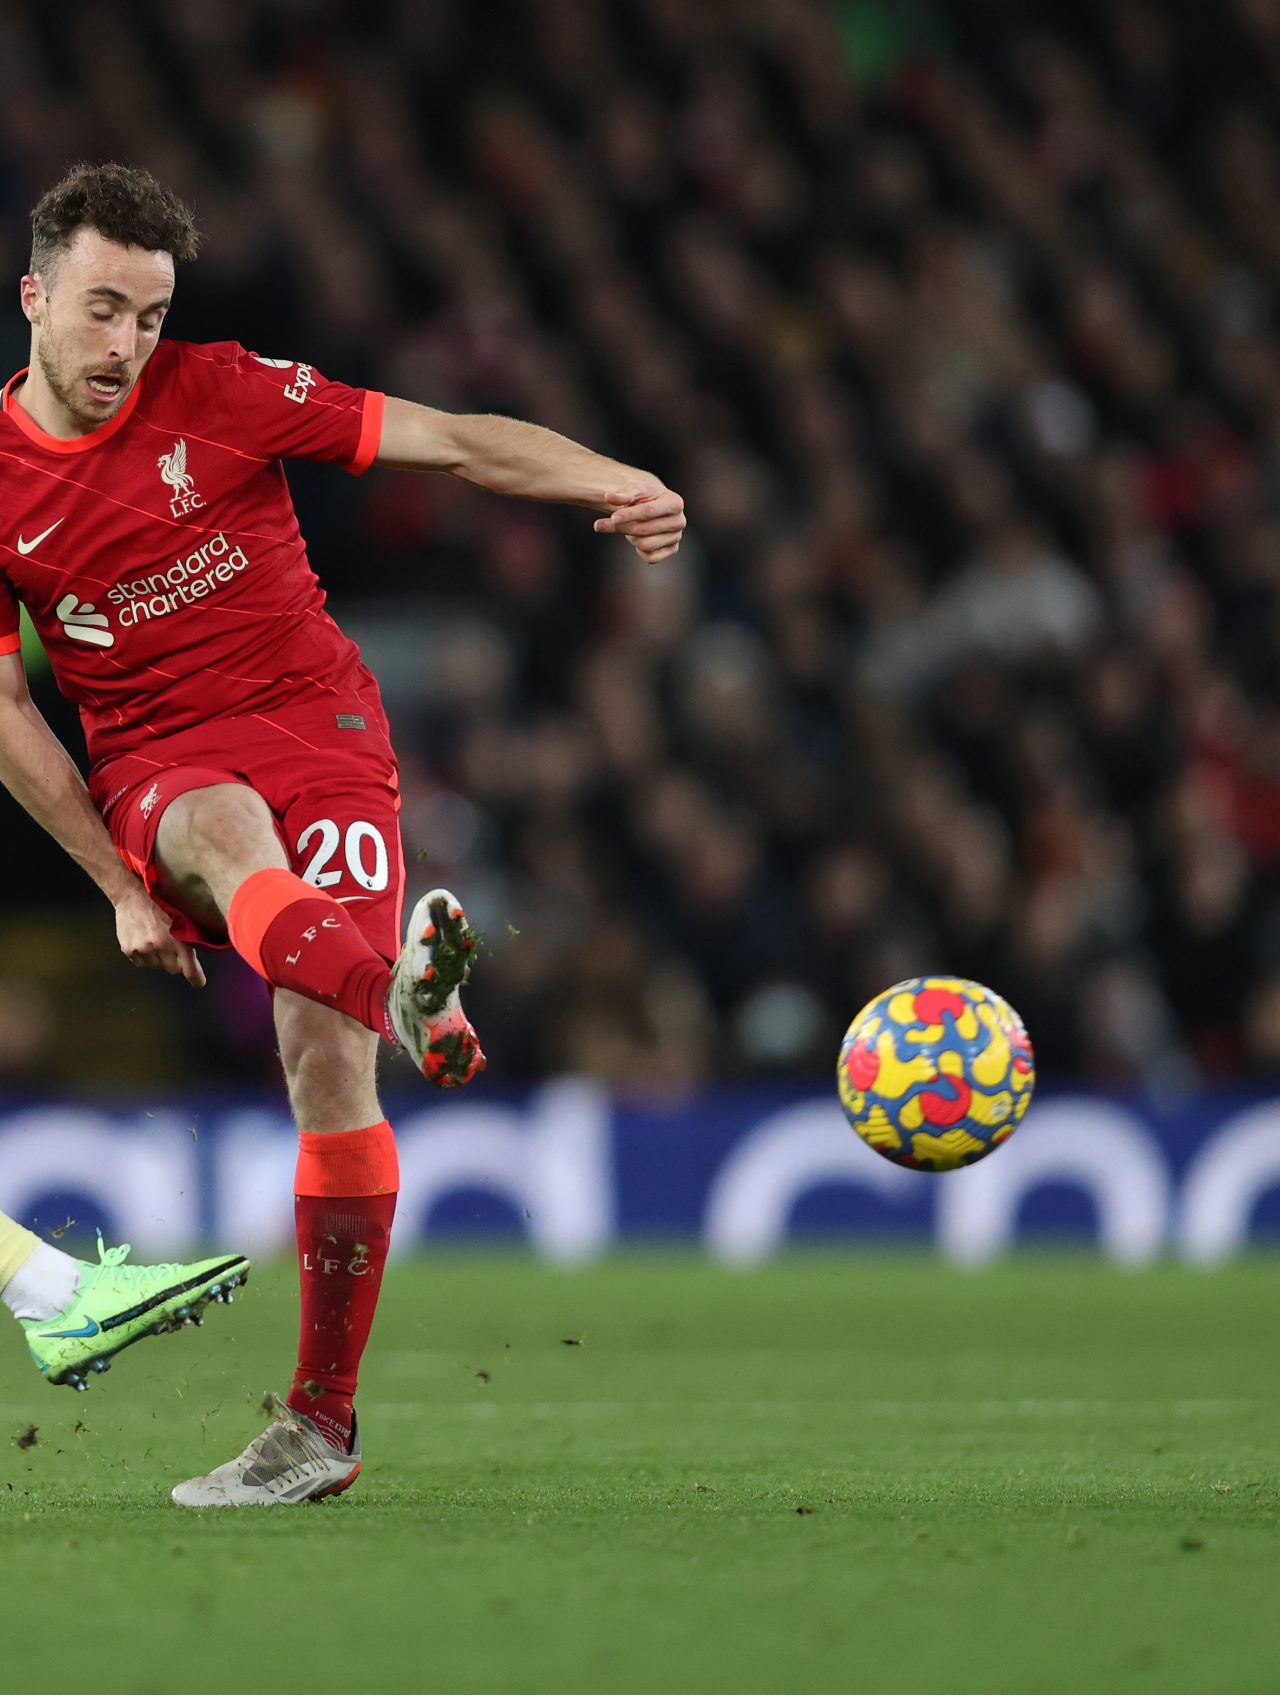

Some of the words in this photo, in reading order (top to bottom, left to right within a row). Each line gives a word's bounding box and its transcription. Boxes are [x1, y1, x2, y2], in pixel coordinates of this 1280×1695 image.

[107, 531, 231, 605] standard
[118, 545, 250, 627] chartered
[296, 818, 389, 892] 20
